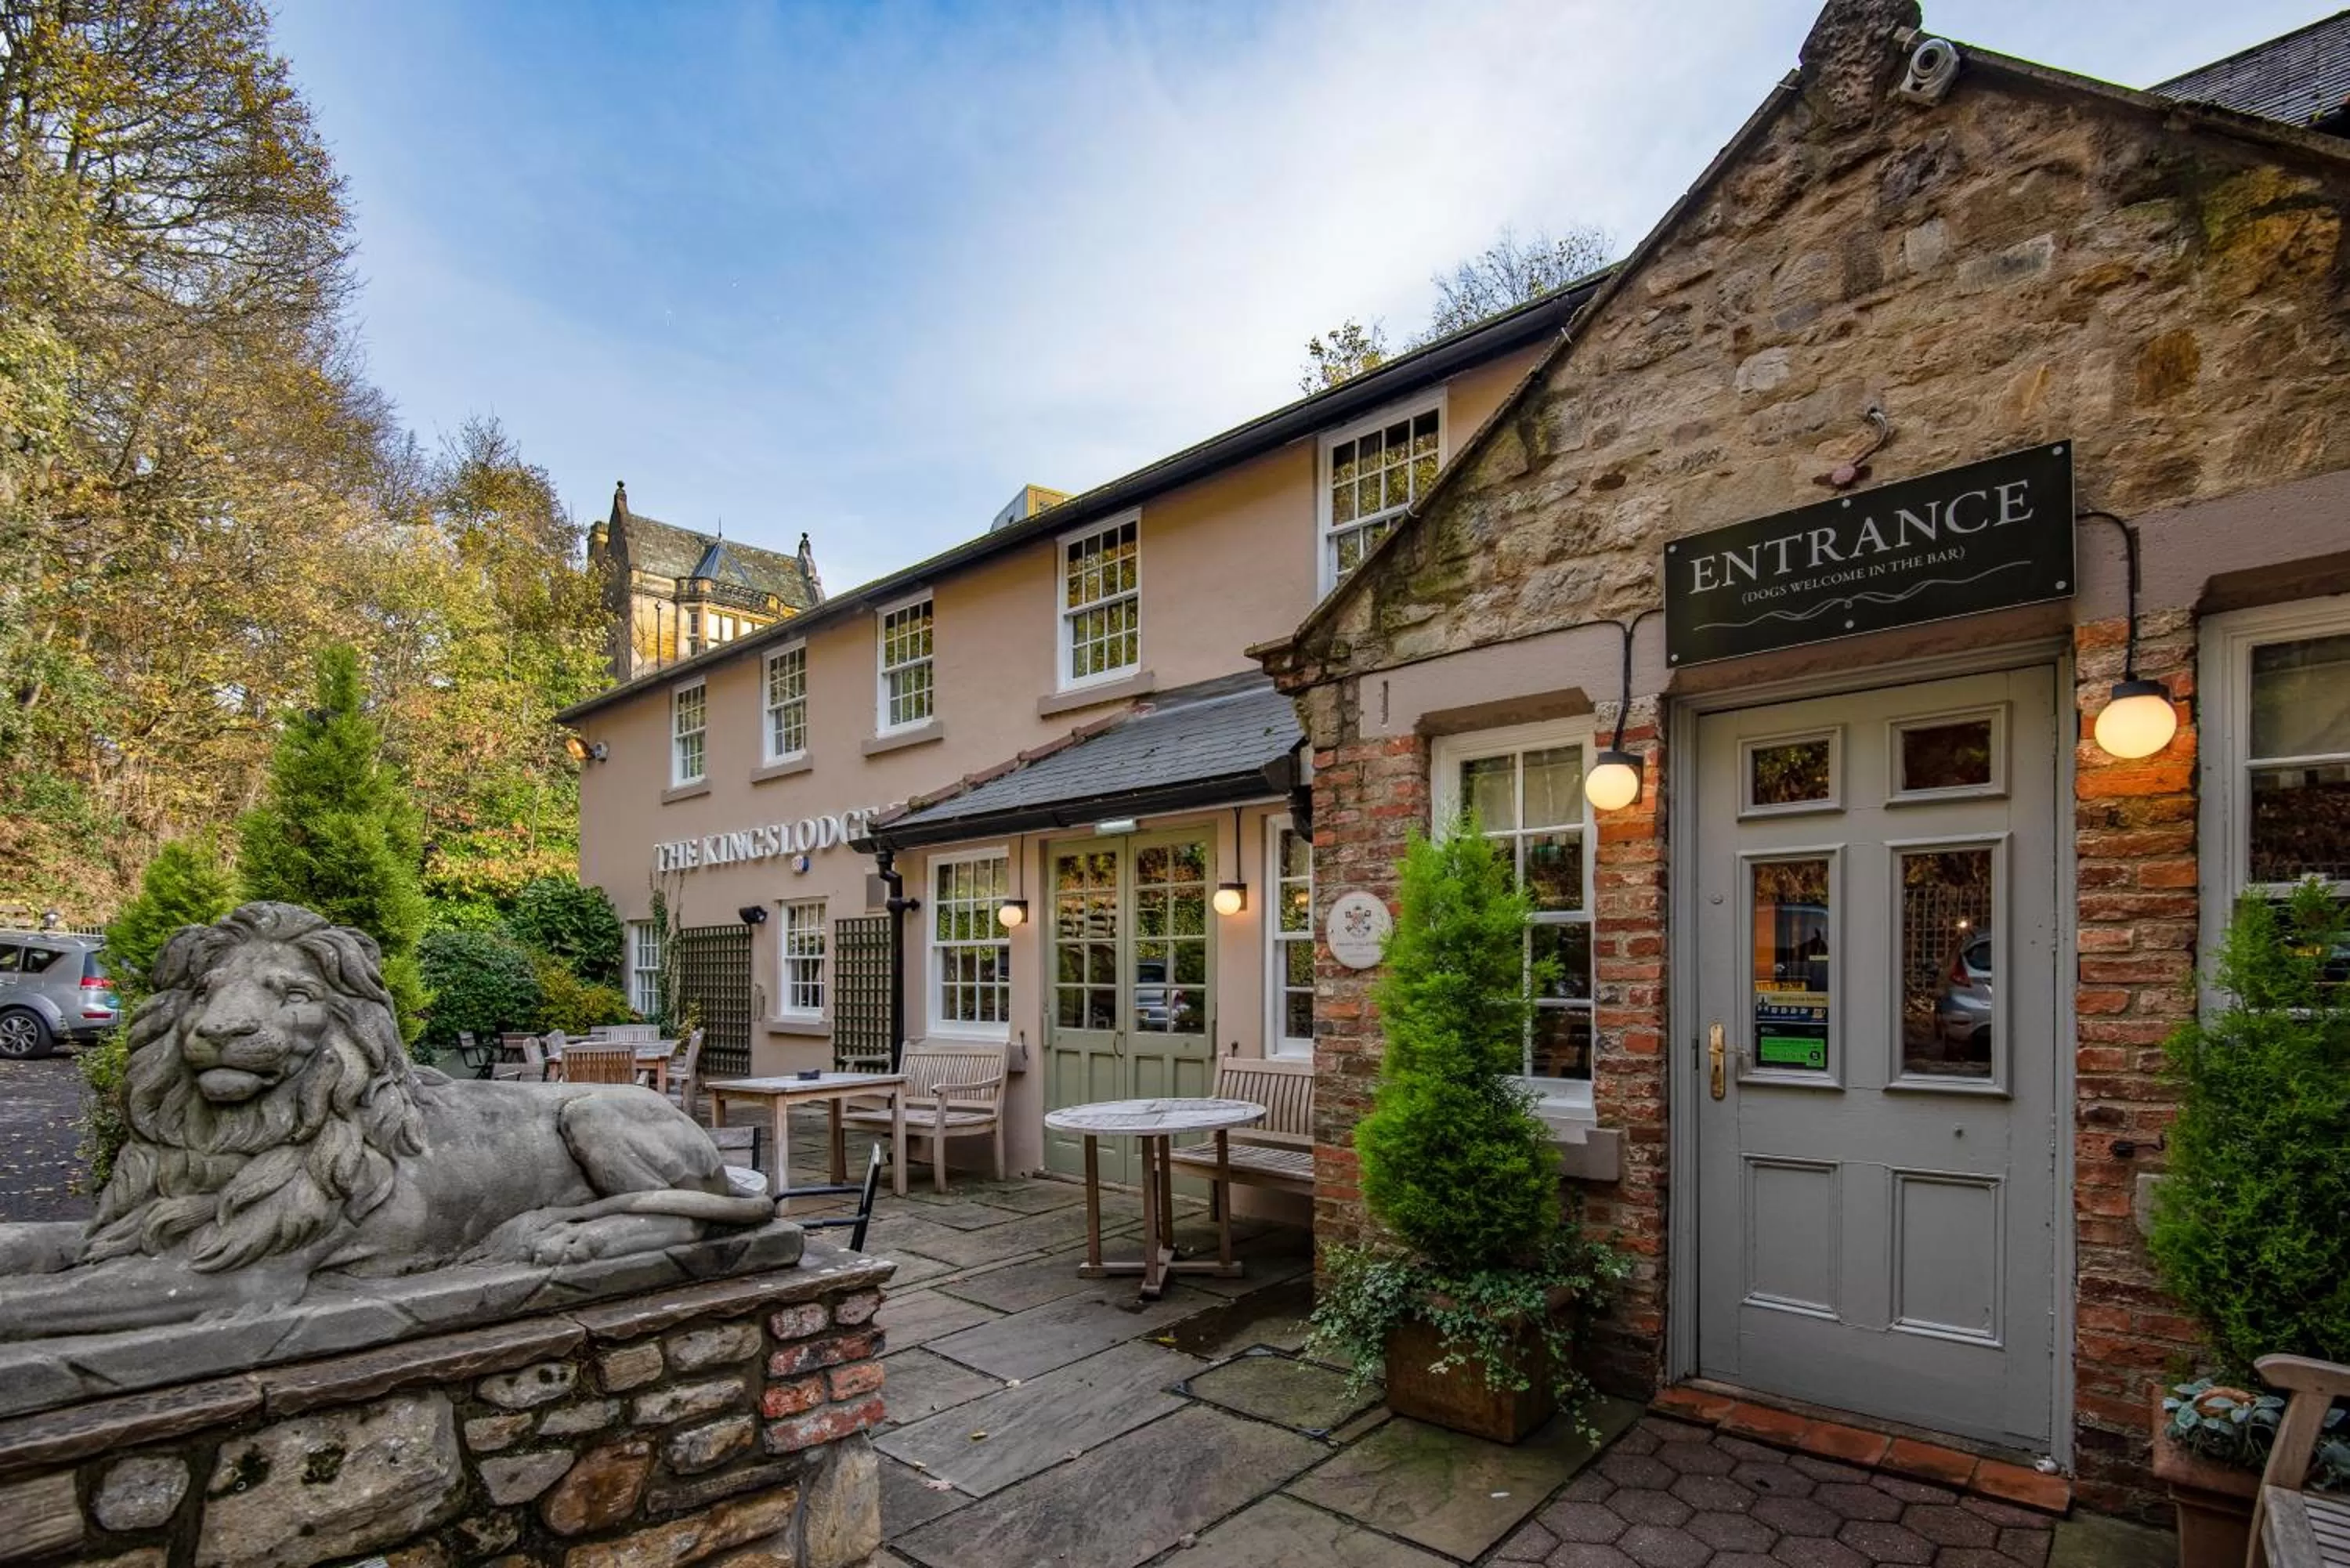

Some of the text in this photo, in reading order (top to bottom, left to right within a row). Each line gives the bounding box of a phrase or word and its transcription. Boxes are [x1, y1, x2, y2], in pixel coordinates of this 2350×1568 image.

[1689, 479, 2034, 594] ENTRANCE
[1741, 546, 1966, 605] (DOGS WELCOME IN THE BAR)
[653, 839, 699, 871] THE
